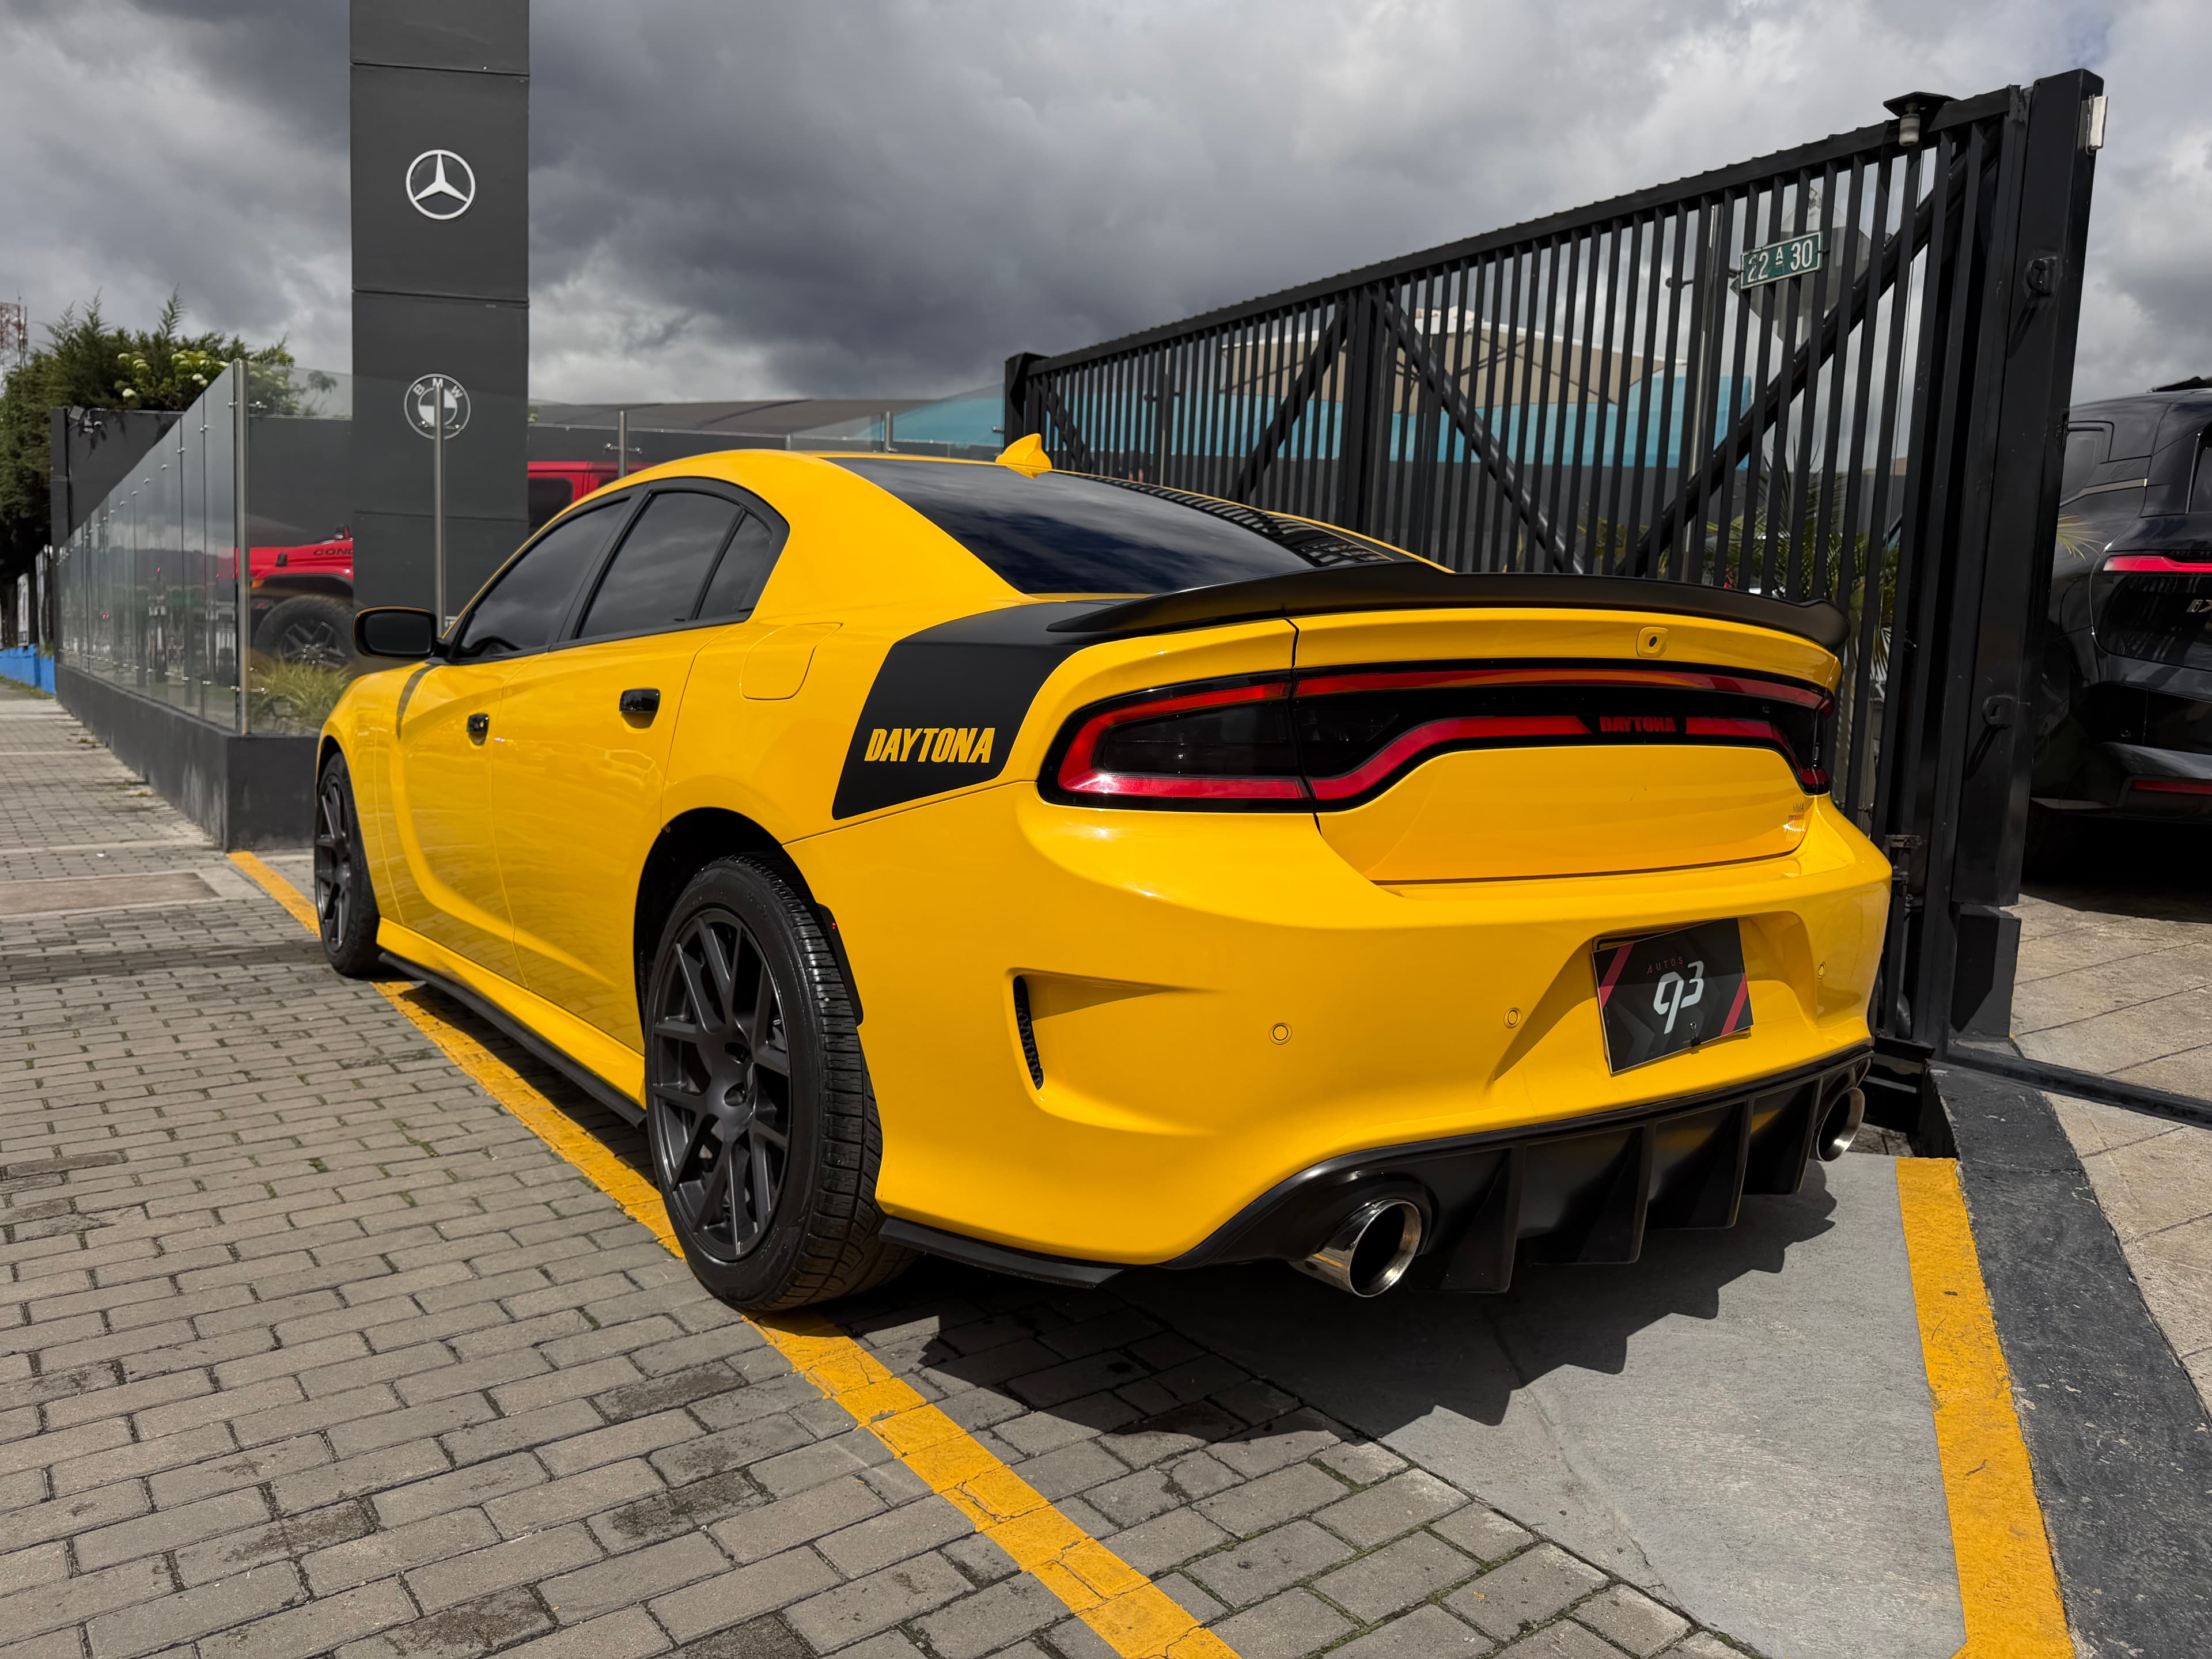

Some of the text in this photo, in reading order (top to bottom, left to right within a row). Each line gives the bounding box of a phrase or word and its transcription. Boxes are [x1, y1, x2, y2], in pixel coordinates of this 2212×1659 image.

[1747, 252, 1769, 283] 22
[1790, 239, 1813, 271] 30
[413, 377, 463, 399] BMW
[1600, 716, 1677, 732] DAYTONA
[864, 728, 995, 763] DAYTONA
[1647, 956, 1683, 974] AUTOS
